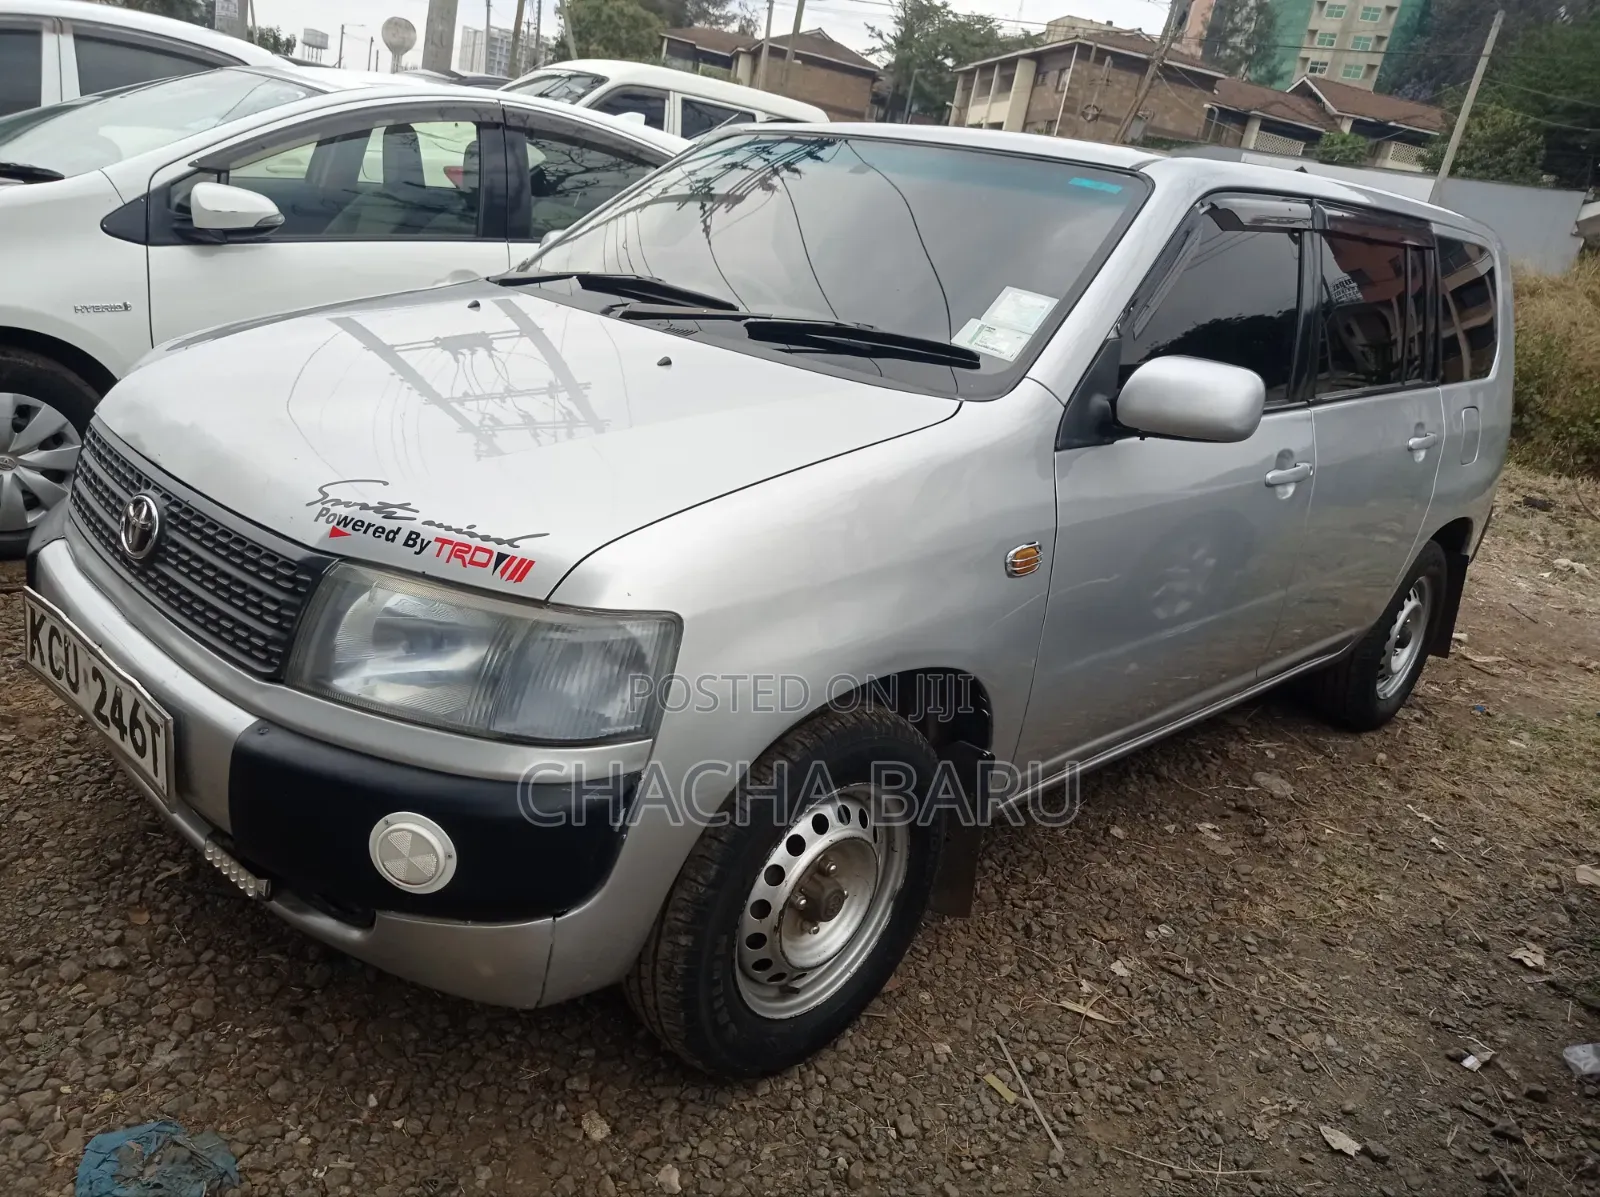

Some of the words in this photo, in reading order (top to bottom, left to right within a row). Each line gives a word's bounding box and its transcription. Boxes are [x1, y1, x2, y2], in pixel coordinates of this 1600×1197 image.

[74, 304, 123, 313] HYBRID
[314, 507, 402, 543] Powered
[402, 530, 432, 555] By
[434, 536, 494, 568] TRD
[29, 606, 80, 695] KCU
[91, 666, 161, 778] 246T
